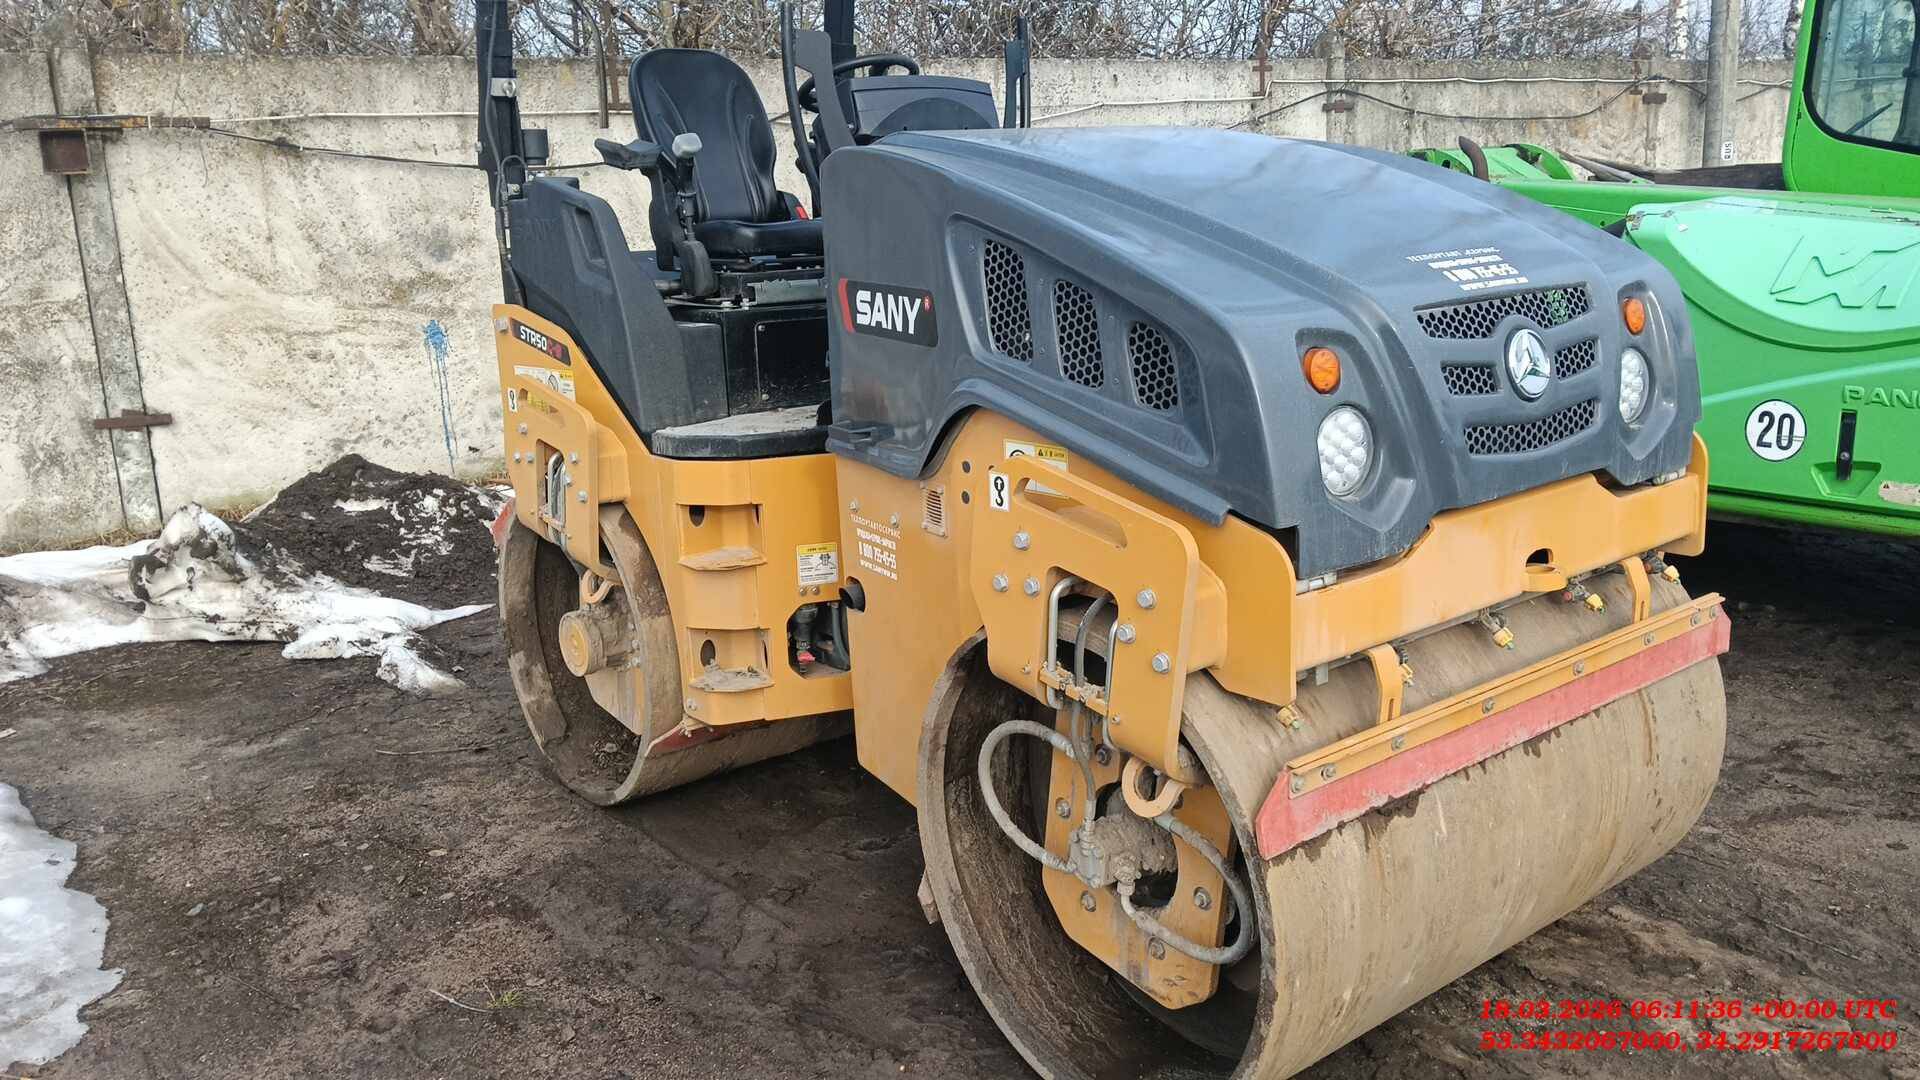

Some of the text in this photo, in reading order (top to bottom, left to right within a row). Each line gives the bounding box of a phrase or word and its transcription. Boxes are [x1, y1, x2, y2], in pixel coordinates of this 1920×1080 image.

[856, 290, 921, 334] SANY
[1843, 384, 1920, 409] PAN
[1756, 410, 1796, 450] 20
